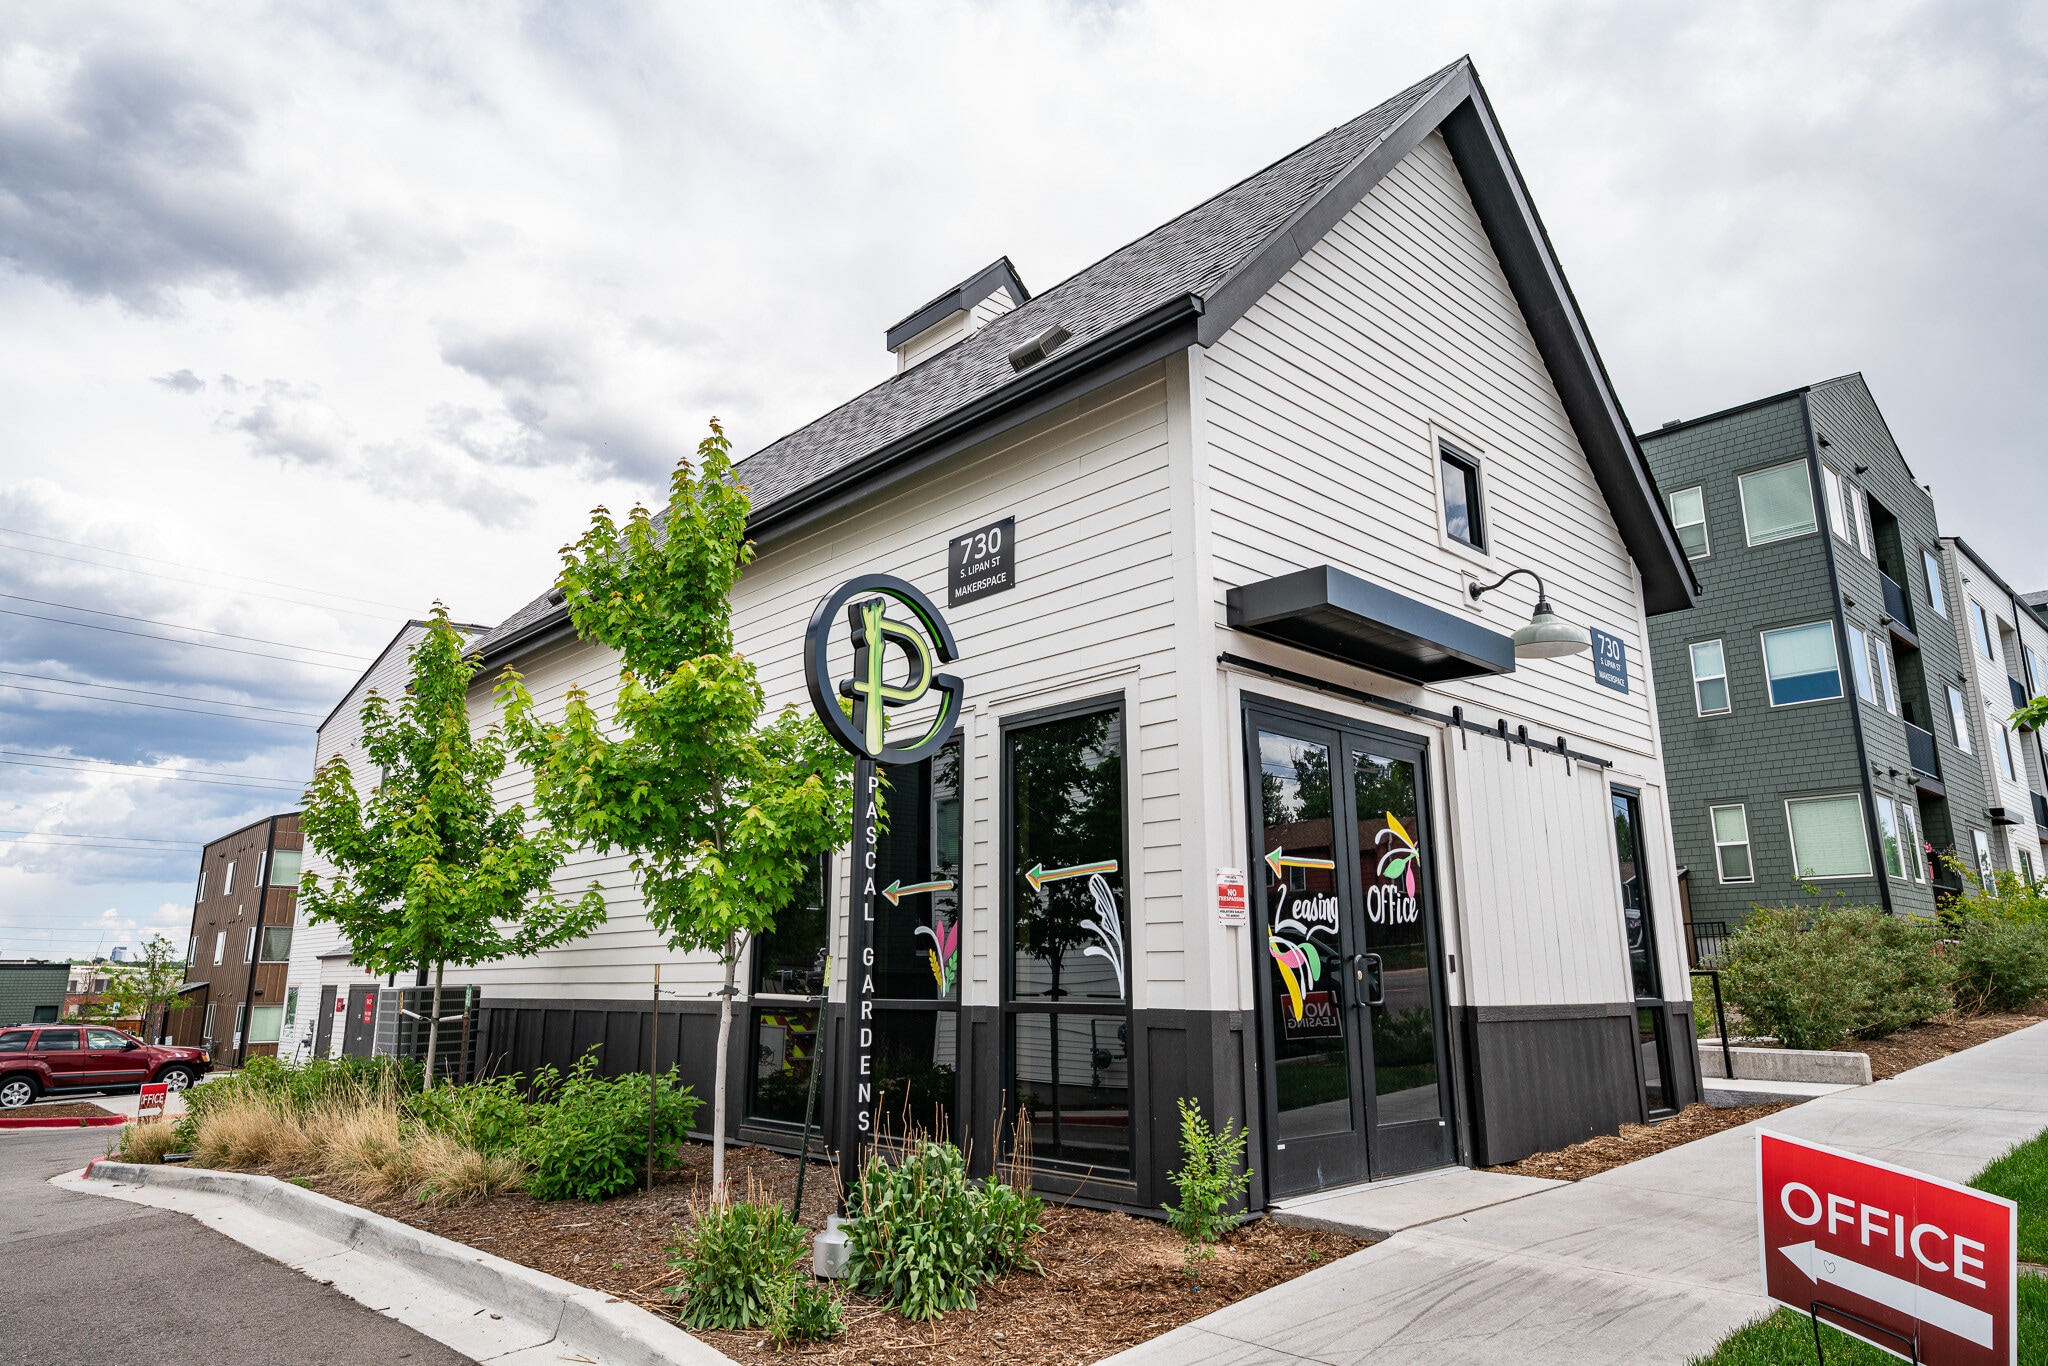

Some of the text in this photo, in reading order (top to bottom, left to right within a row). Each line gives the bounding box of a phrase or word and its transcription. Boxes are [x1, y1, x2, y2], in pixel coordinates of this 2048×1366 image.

[961, 527, 1002, 565] 730
[960, 555, 1001, 579] S. LIPAN ST
[954, 571, 1007, 598] MAKERSPACE
[1597, 633, 1620, 661] 730
[1604, 658, 1617, 670] LIPAN
[1598, 669, 1626, 688] MAKERSPACE
[863, 776, 879, 923] PASCAL
[1227, 888, 1237, 897] NO
[1275, 883, 1339, 941] Leasing
[857, 947, 875, 1132] GARDENS
[141, 1093, 165, 1105] OFFICE
[1780, 1182, 1987, 1290] OFFICE
